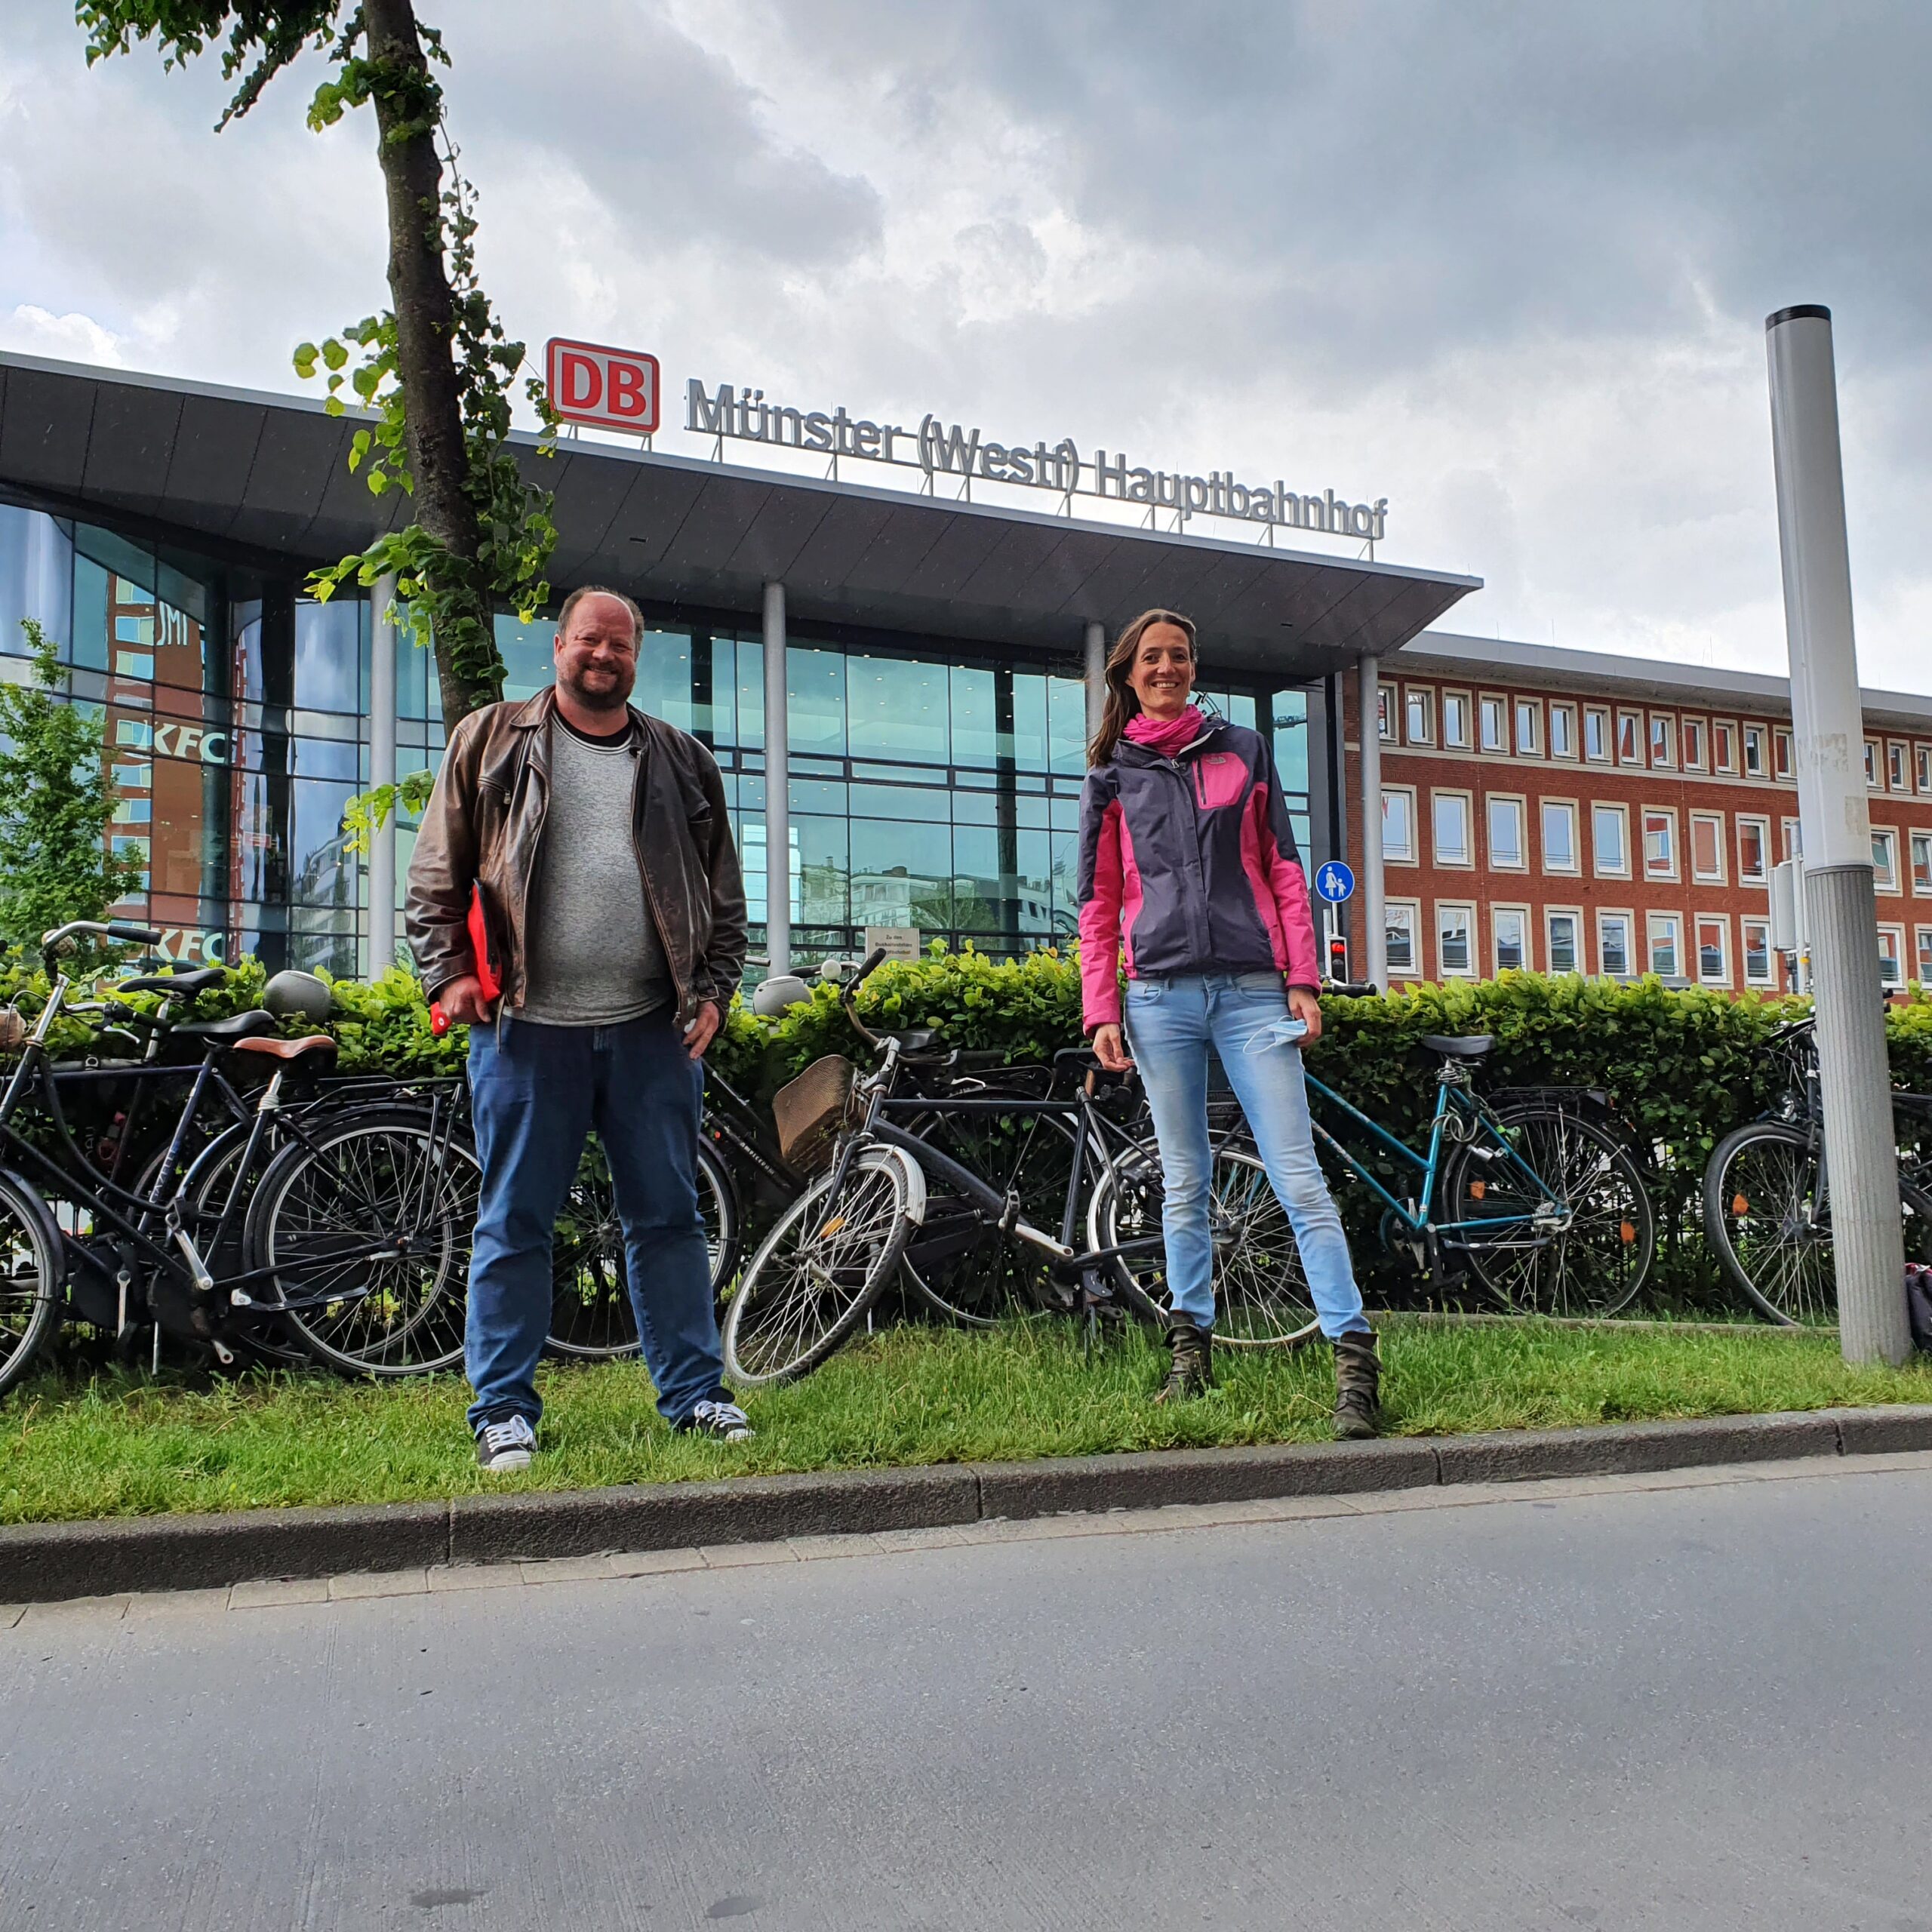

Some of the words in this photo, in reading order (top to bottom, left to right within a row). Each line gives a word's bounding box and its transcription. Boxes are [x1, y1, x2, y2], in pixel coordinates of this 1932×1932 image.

[561, 352, 647, 417] DB
[686, 377, 902, 461] Münster
[916, 413, 1079, 497] (Westf)
[1094, 449, 1389, 540] Hauptbahnhof
[135, 719, 226, 764] KFC
[138, 927, 223, 961] KFC
